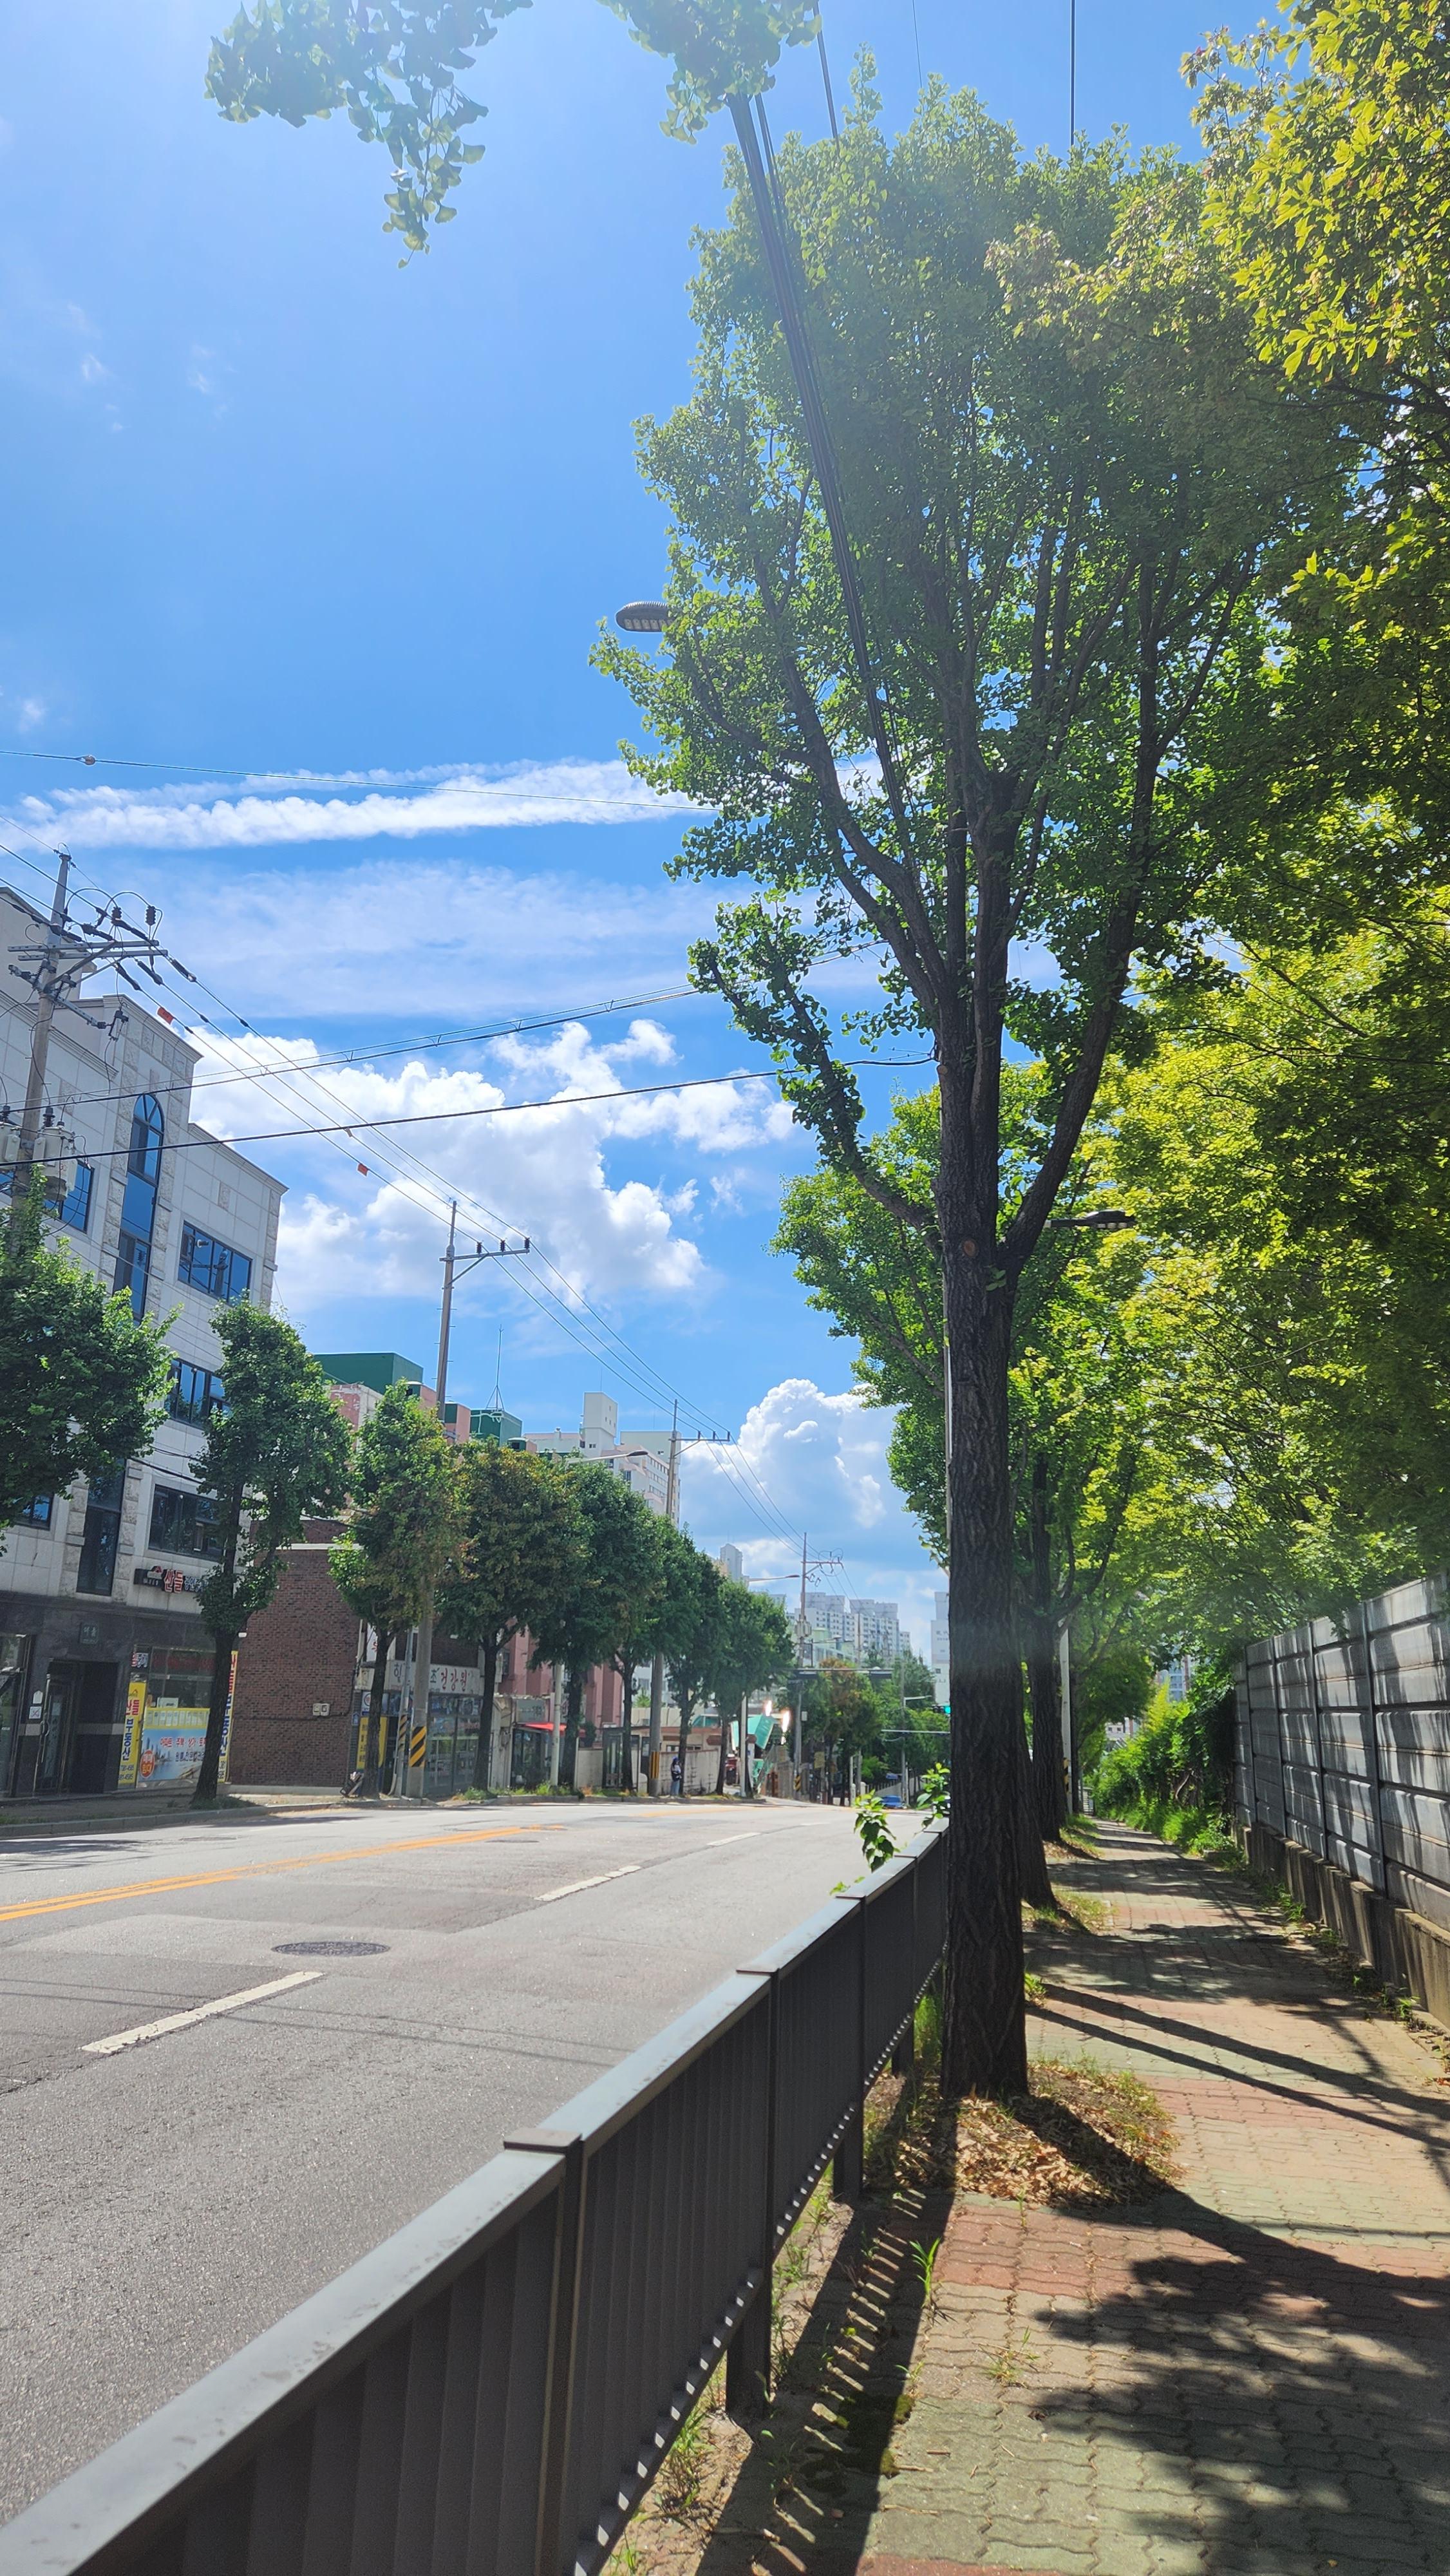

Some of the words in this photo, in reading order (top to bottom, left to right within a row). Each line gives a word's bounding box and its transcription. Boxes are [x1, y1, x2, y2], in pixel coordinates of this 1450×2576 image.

[164, 1569, 184, 1593] 산들
[441, 1667, 467, 1692] 건강원
[122, 1718, 134, 1761] 부동산
